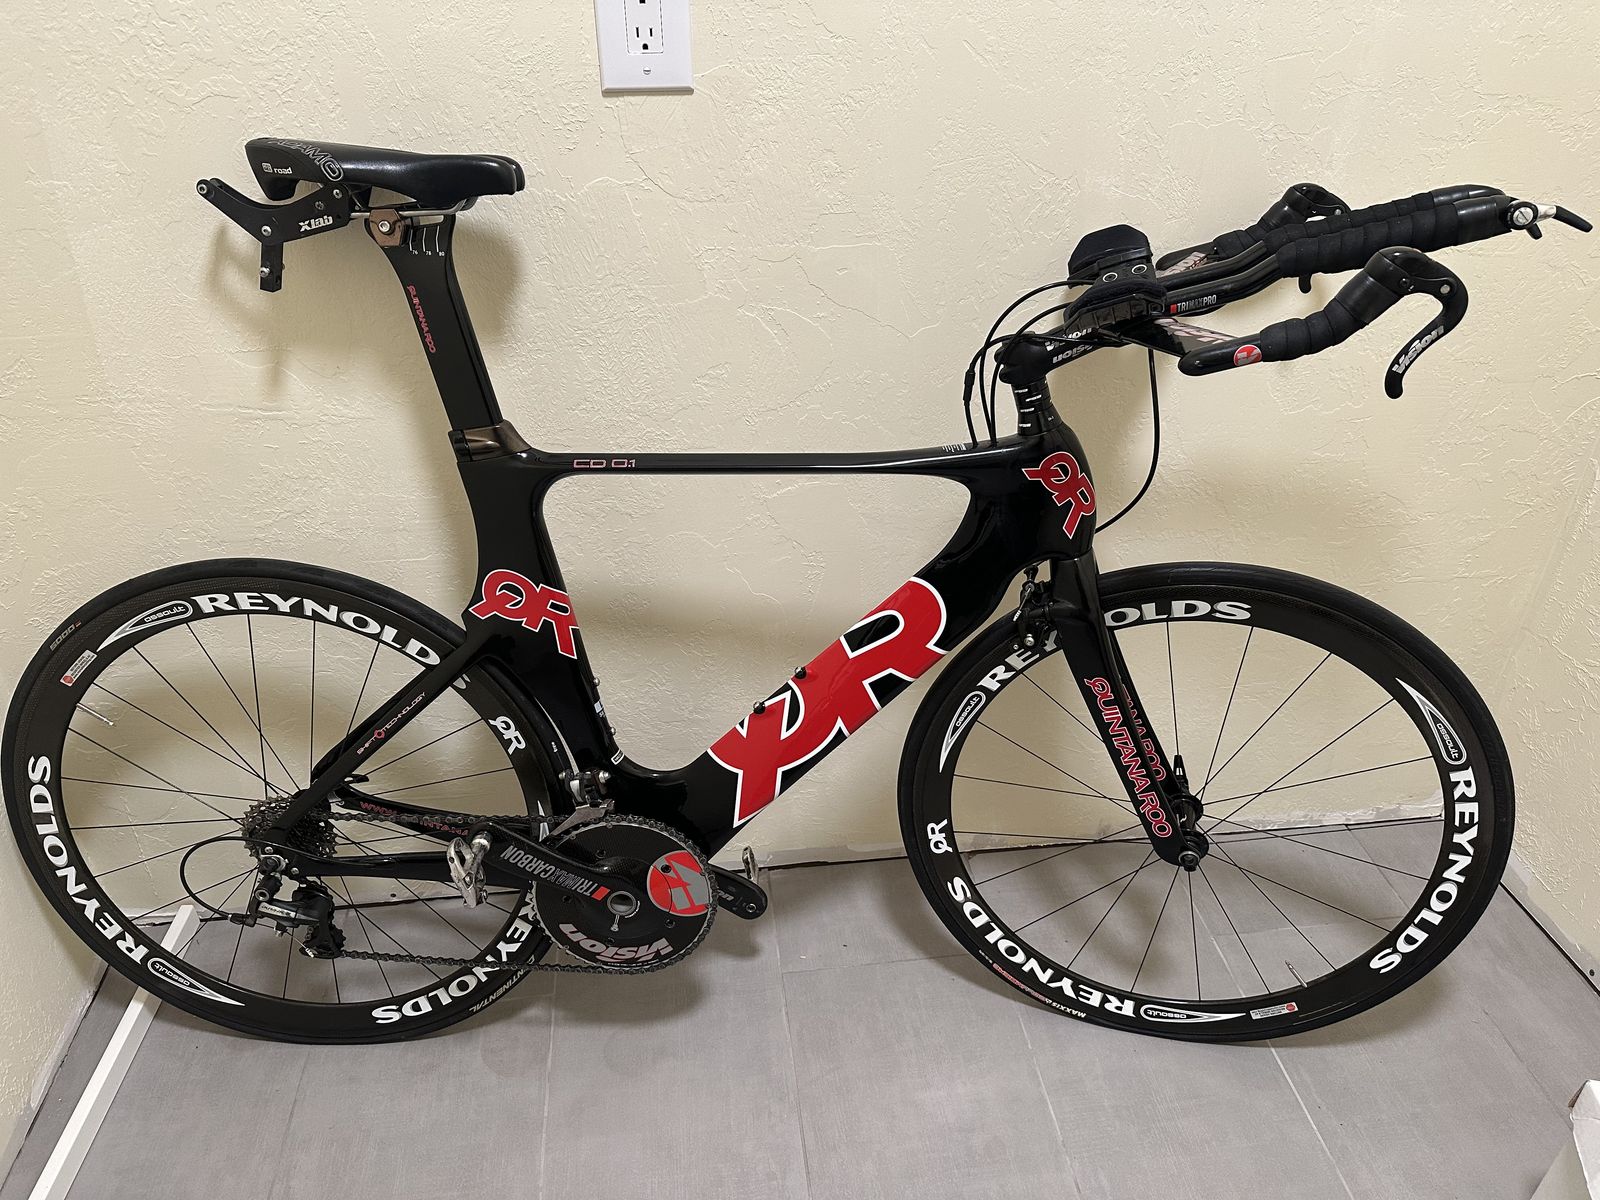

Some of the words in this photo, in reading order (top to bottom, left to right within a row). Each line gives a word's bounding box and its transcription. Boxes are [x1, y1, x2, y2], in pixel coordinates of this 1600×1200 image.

[573, 459, 607, 469] CD
[611, 459, 636, 468] 0.1
[1023, 451, 1096, 539] QR
[144, 604, 185, 623] assault
[467, 569, 580, 660] QR
[49, 624, 75, 651] 5000
[955, 695, 979, 727] assault
[488, 716, 526, 756] QR
[1436, 723, 1459, 760] assault
[926, 818, 953, 854] QR
[27, 755, 150, 965] REYNOLDS
[1369, 765, 1480, 974] REYNOLDS
[948, 876, 1136, 1018] REYNOLDS
[153, 961, 191, 987] assault
[1052, 1001, 1087, 1018] MAXXIS
[1146, 1008, 1187, 1019] assault
